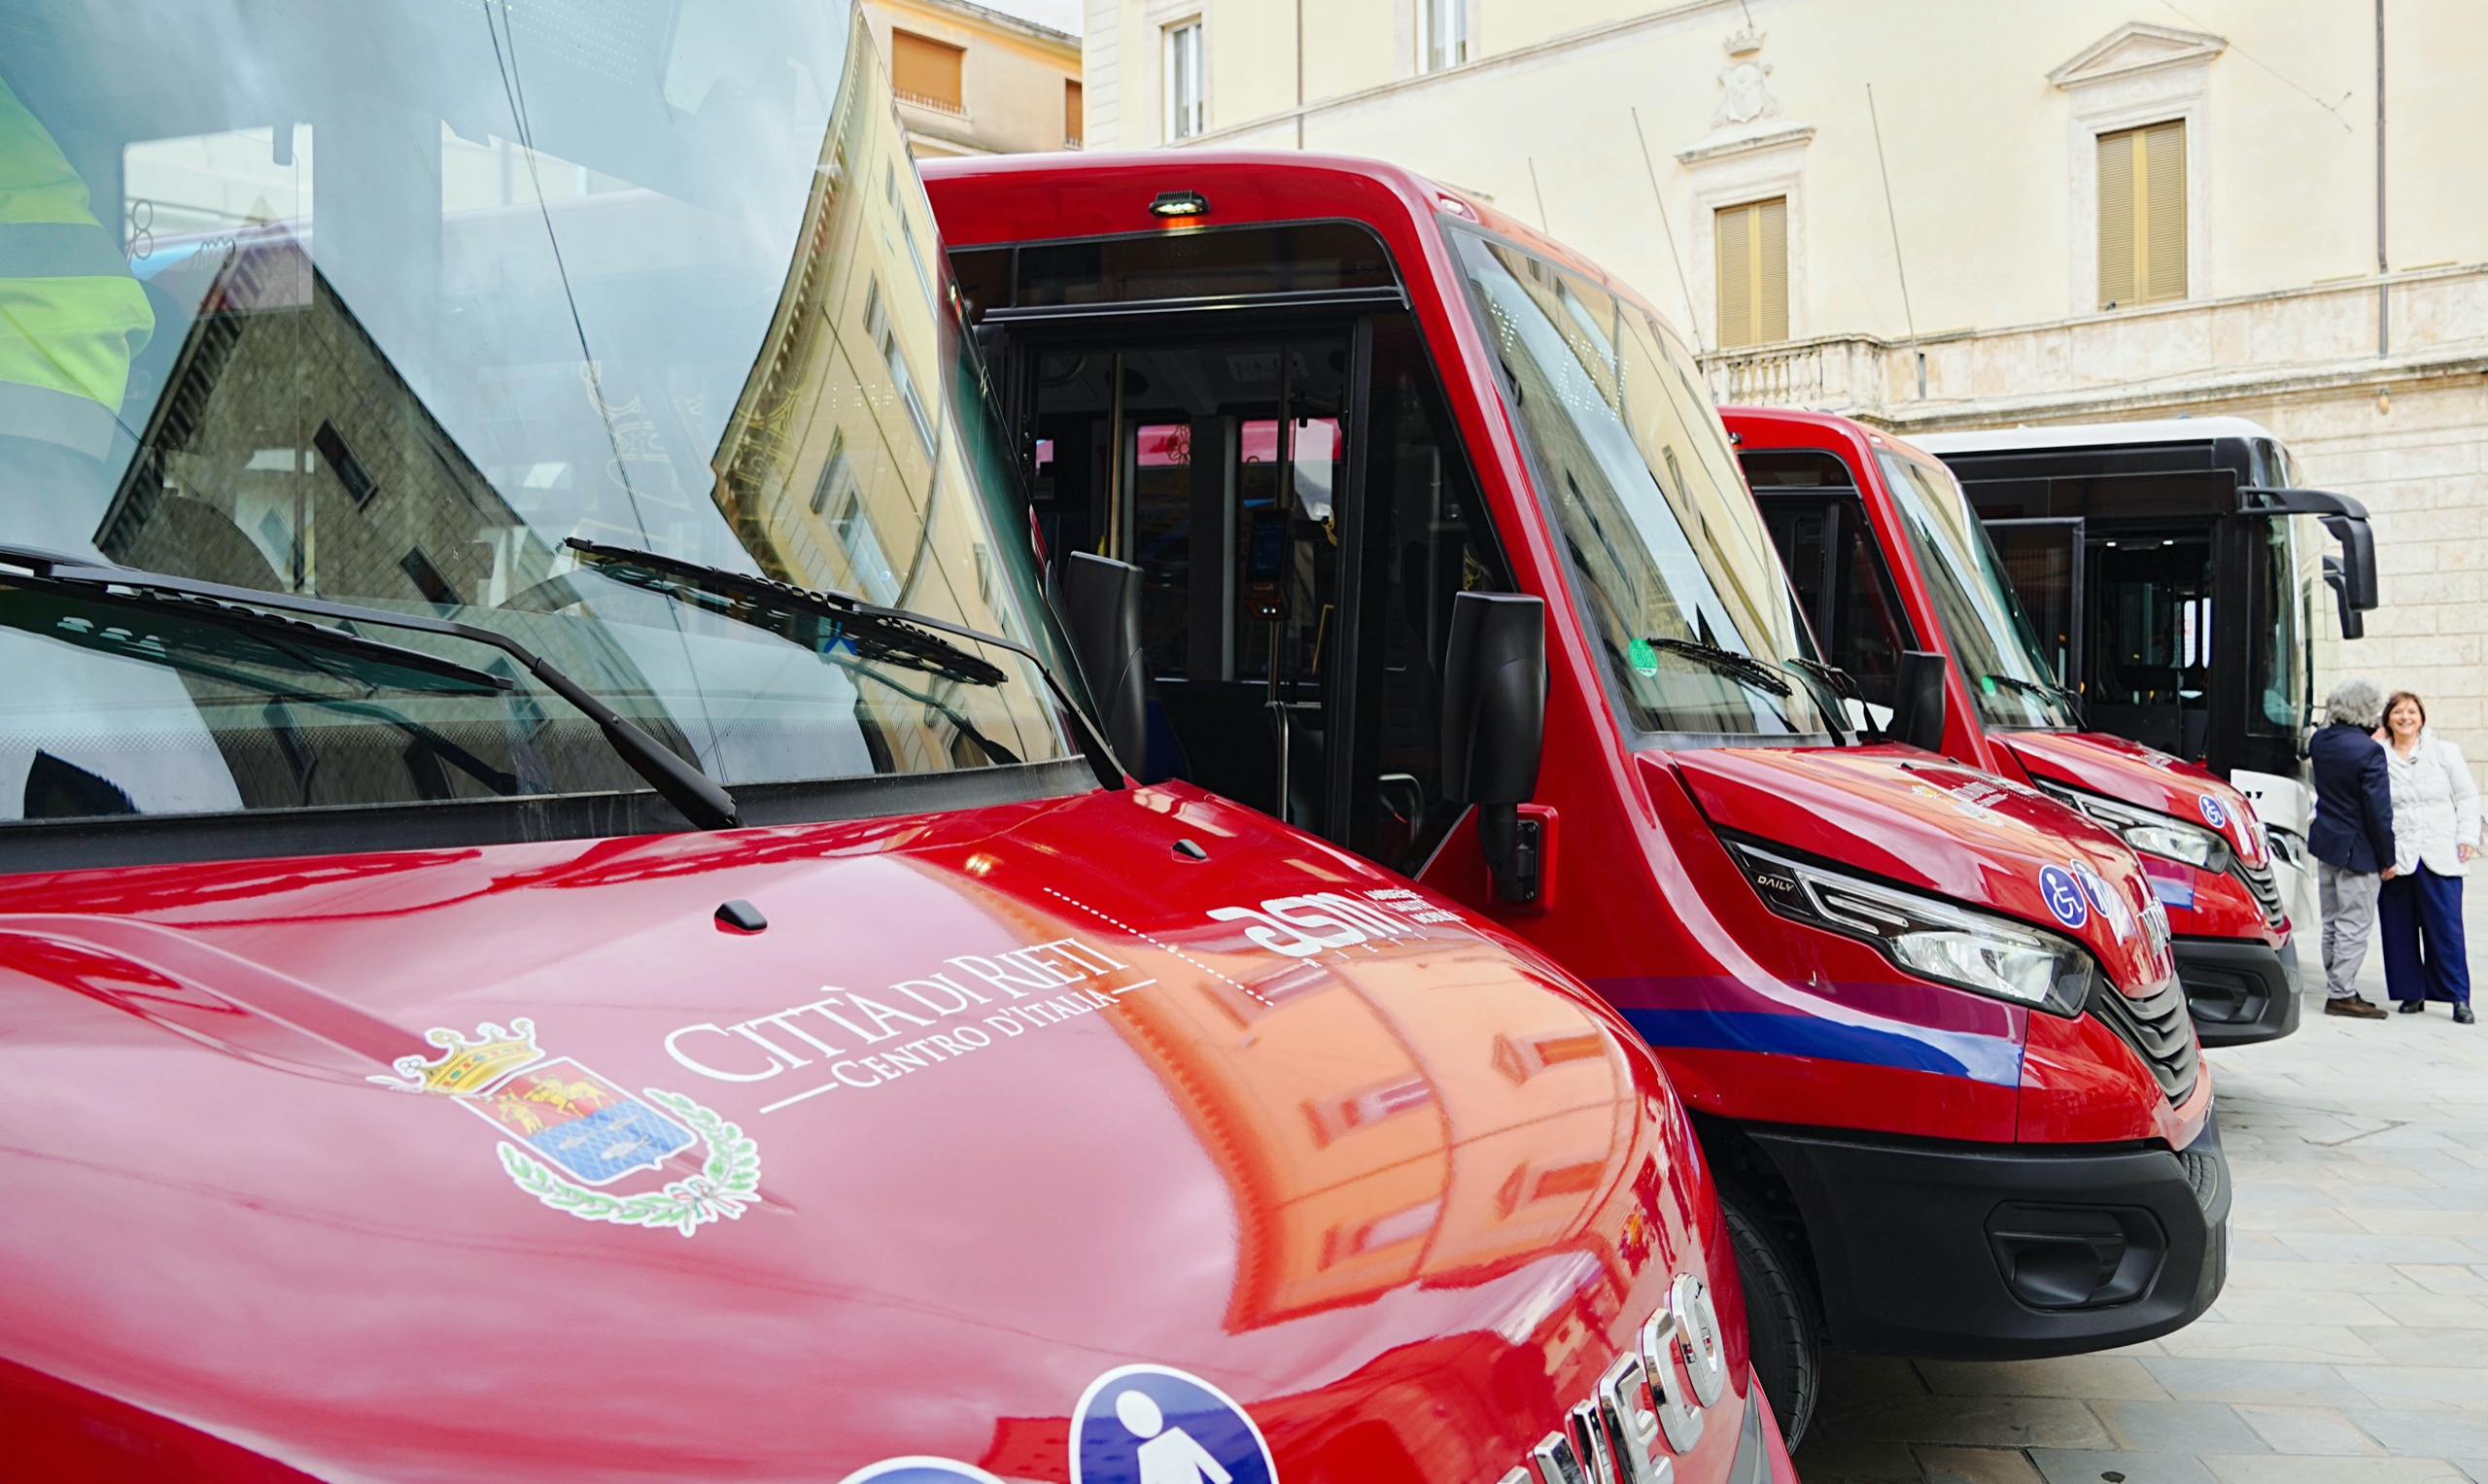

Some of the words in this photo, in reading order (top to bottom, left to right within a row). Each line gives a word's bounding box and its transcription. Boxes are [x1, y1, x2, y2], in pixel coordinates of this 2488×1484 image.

[1632, 647, 1657, 668] OK
[1757, 875, 1794, 892] DAILY
[664, 985, 937, 1083] CITTÀ
[888, 973, 993, 1017] DI
[943, 937, 1129, 999] RIETI
[831, 1026, 991, 1087] CENTRO
[983, 986, 1121, 1038] D'ITALIA
[1497, 1272, 1725, 1484] VECO
